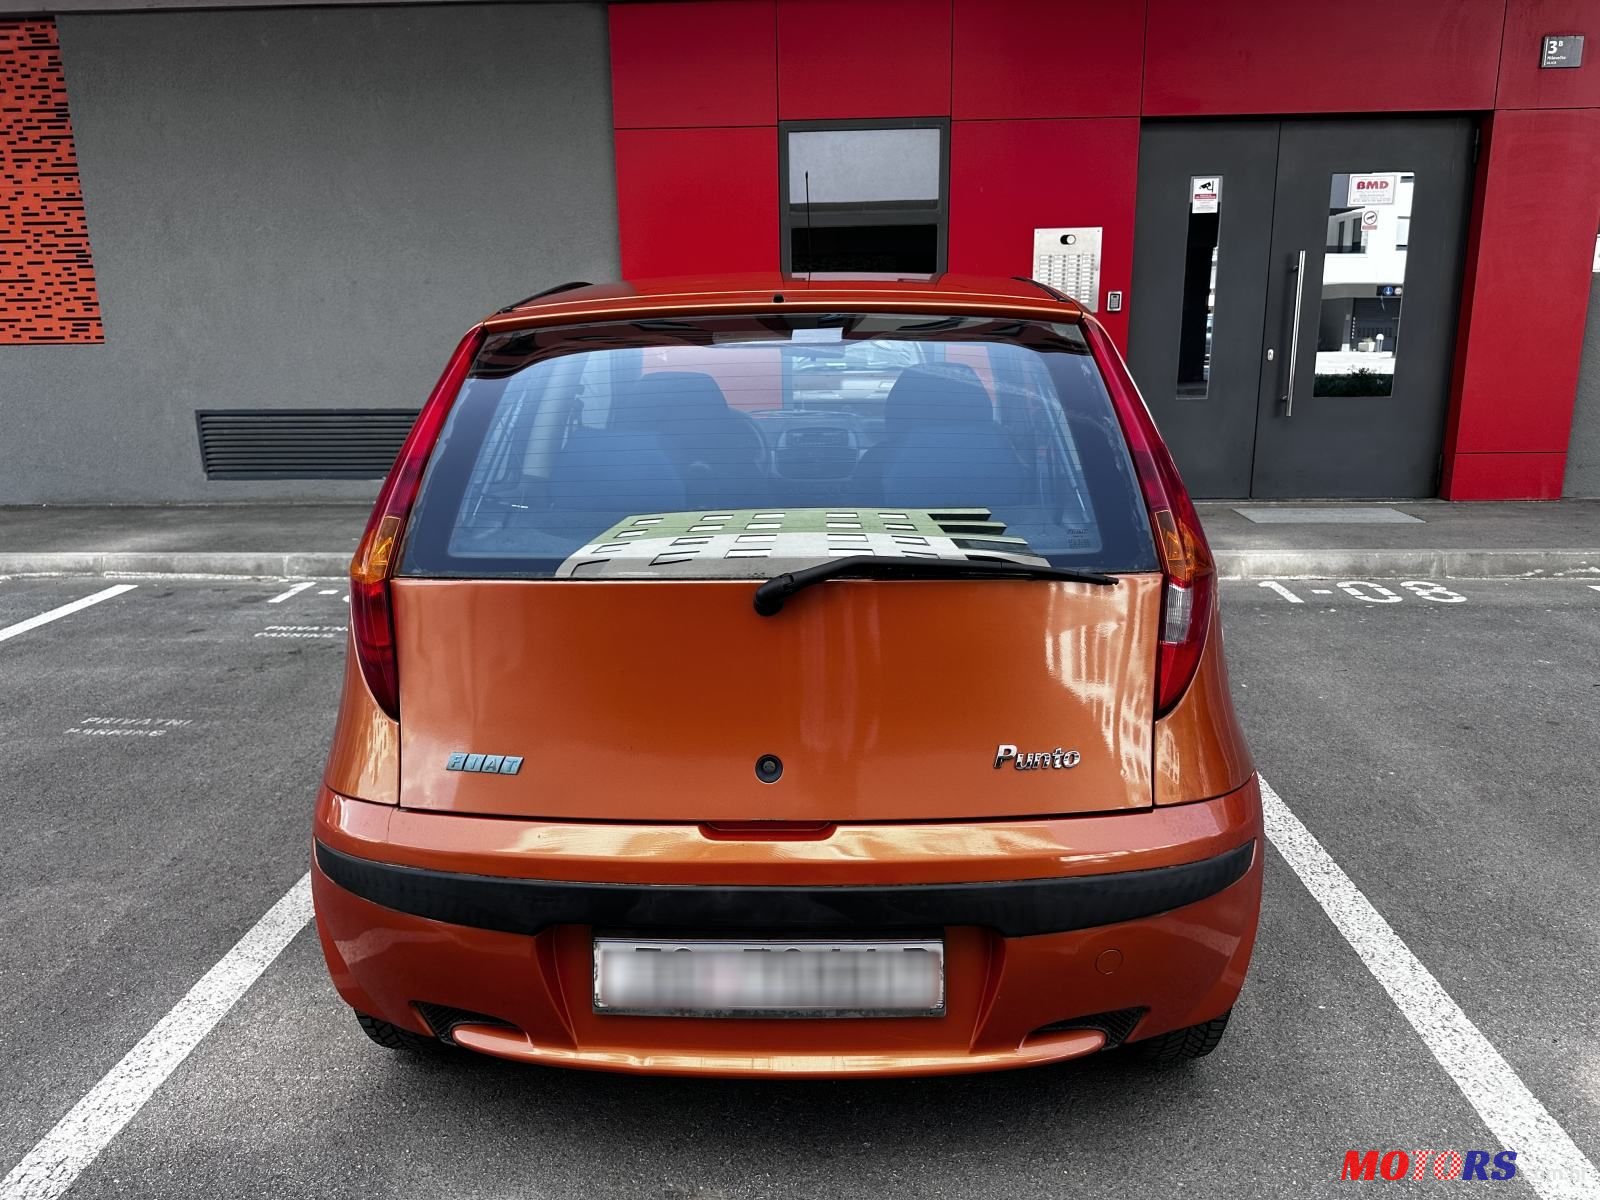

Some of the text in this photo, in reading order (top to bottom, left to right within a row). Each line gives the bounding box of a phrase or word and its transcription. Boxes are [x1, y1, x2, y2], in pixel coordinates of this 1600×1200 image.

[1356, 180, 1389, 190] BMD
[267, 581, 349, 603] 1-
[1258, 580, 1467, 603] 1-08
[447, 753, 522, 774] FIAT
[994, 744, 1080, 769] Punto
